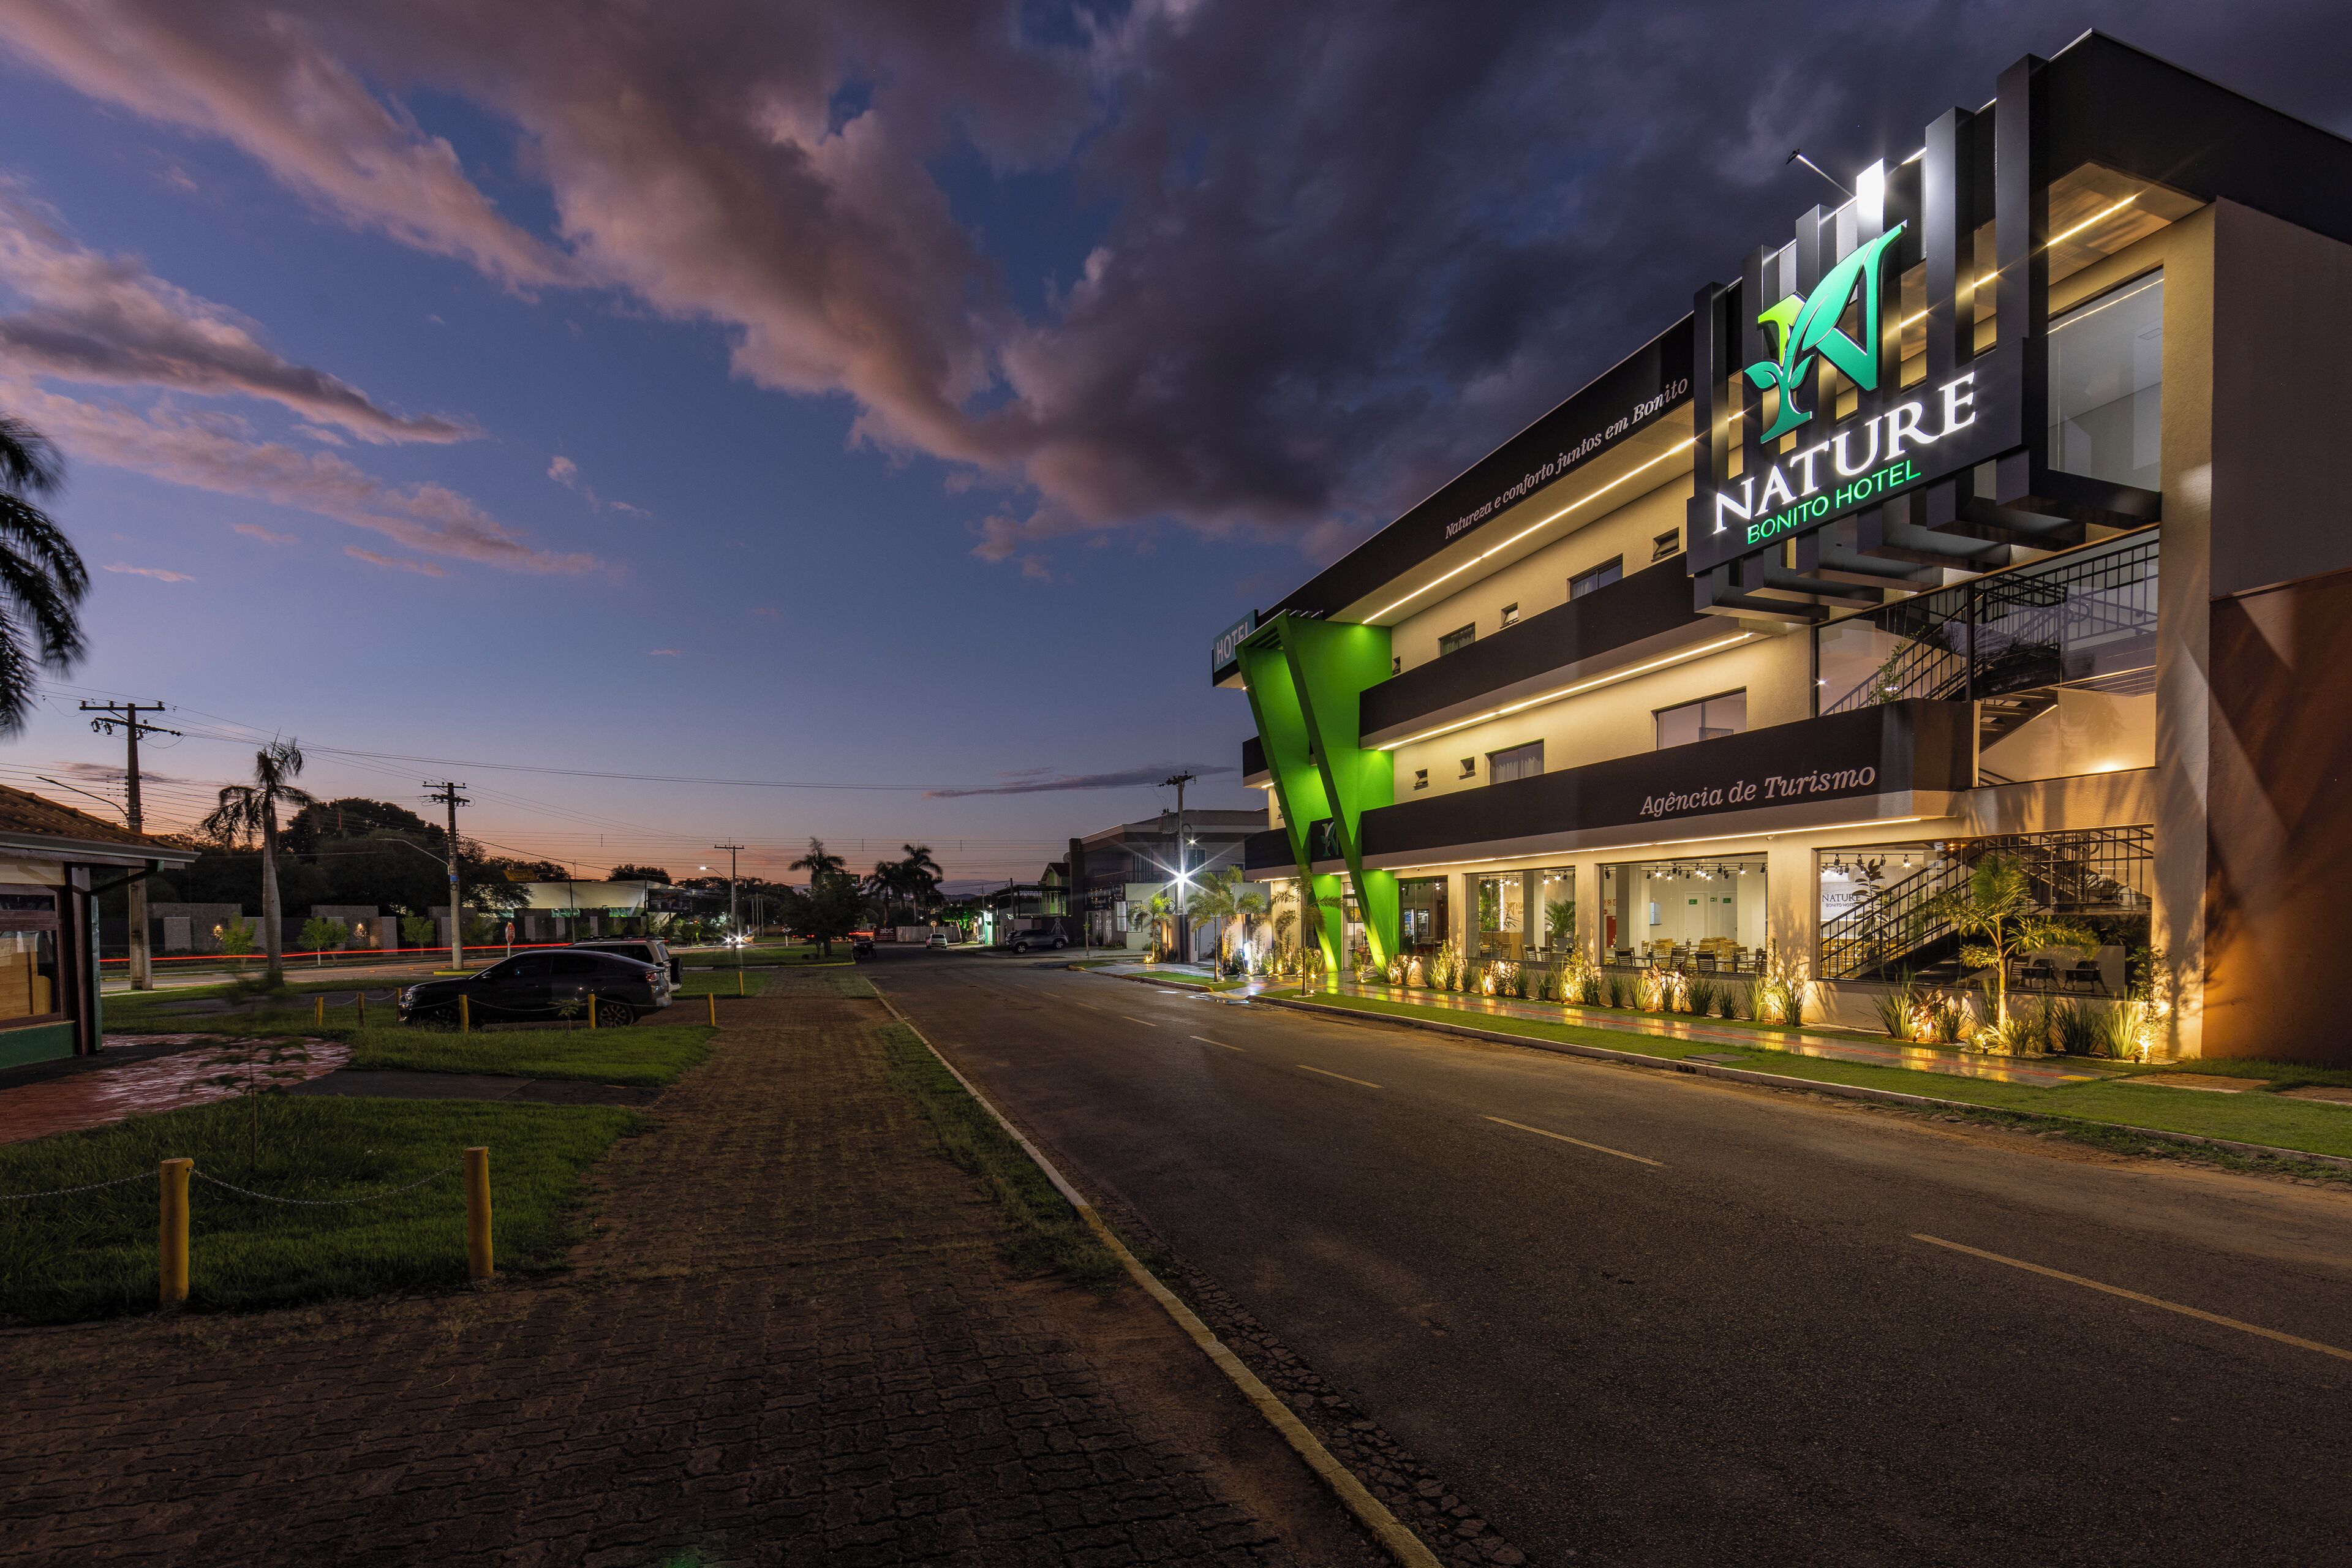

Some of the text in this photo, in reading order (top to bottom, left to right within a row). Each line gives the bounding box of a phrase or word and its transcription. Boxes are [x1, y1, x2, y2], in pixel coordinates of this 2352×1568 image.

[1445, 378, 1688, 540] Natureza e conforto juntos em Bonito
[1713, 371, 1978, 535] NATURE
[1747, 459, 1921, 545] BONITO HOTEL
[1640, 766, 1875, 817] Agência de Turismo
